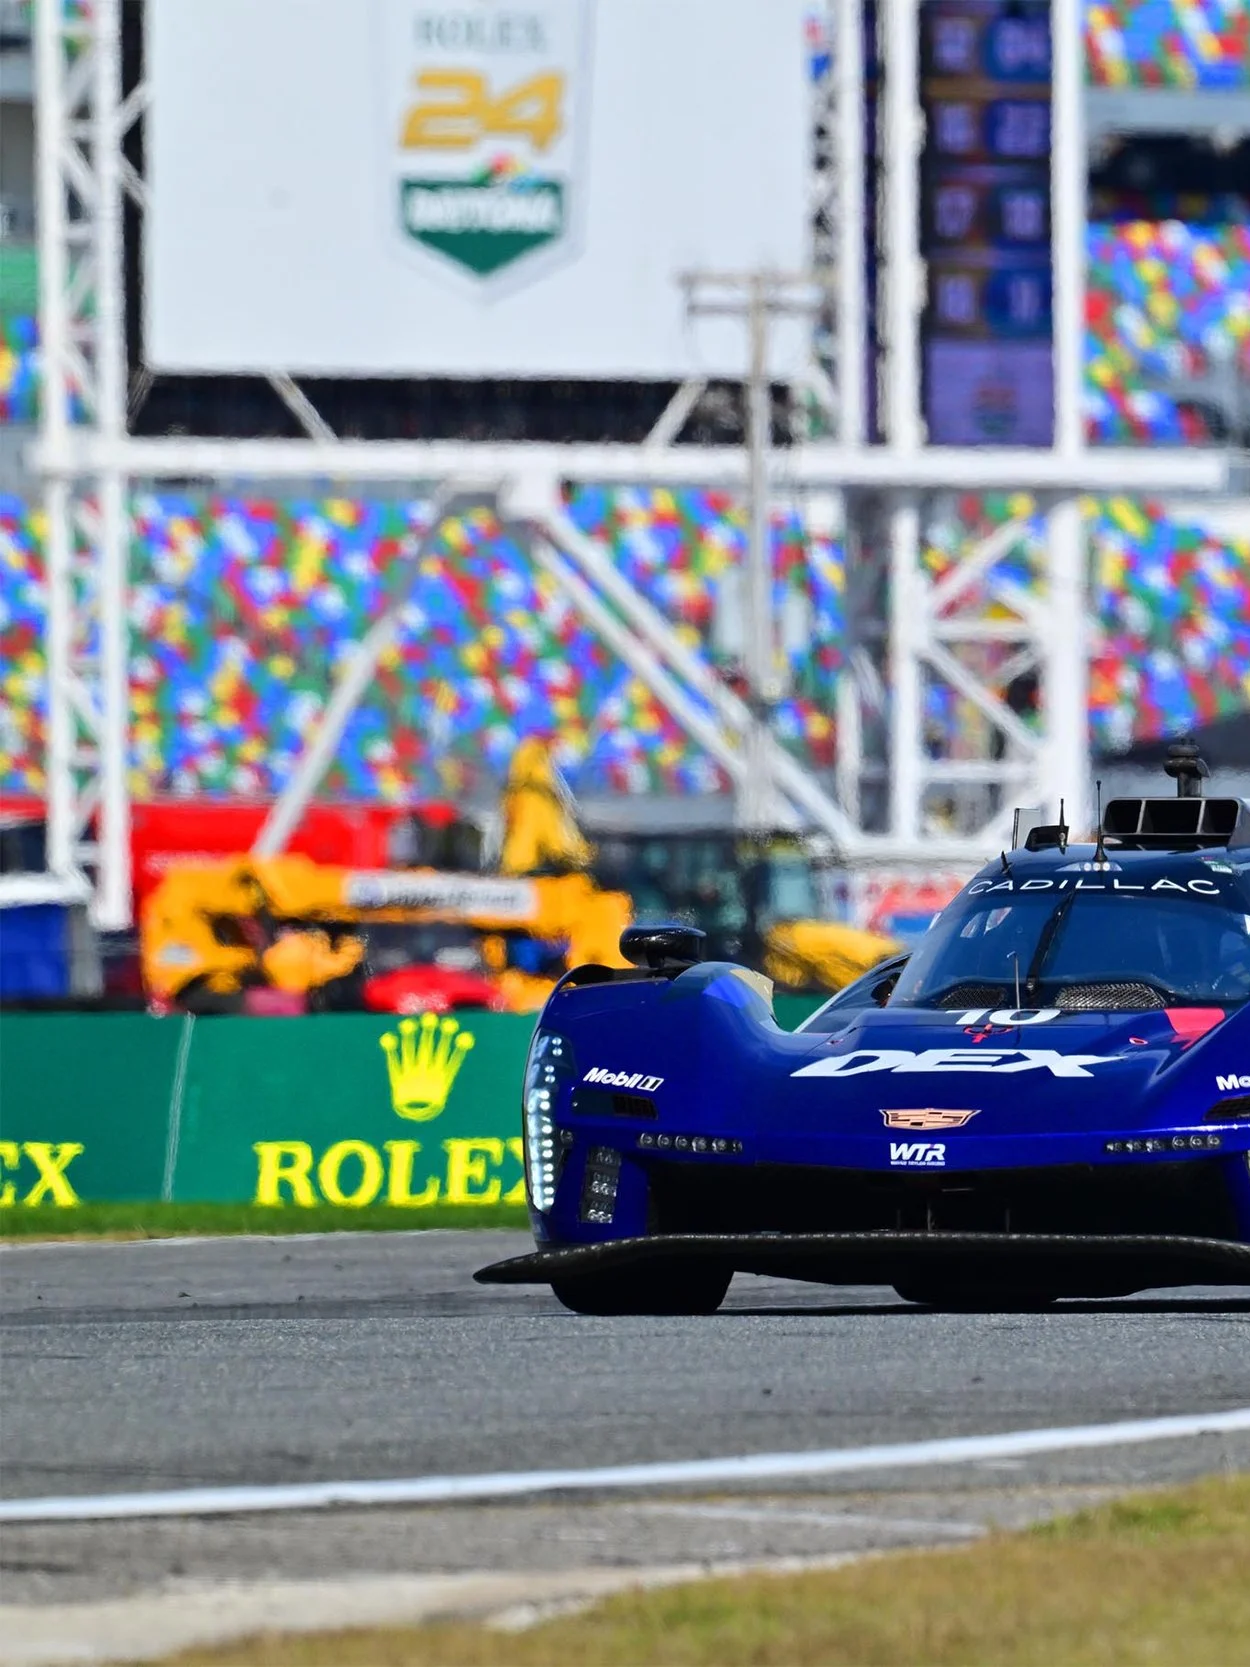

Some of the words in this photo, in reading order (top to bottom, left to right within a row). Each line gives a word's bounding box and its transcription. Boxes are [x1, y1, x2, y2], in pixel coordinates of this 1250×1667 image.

[401, 69, 567, 152] 24
[968, 879, 1221, 895] CADILLAC
[945, 1008, 1061, 1026] 10
[789, 1049, 1130, 1078] DEX
[890, 1142, 946, 1162] WTR
